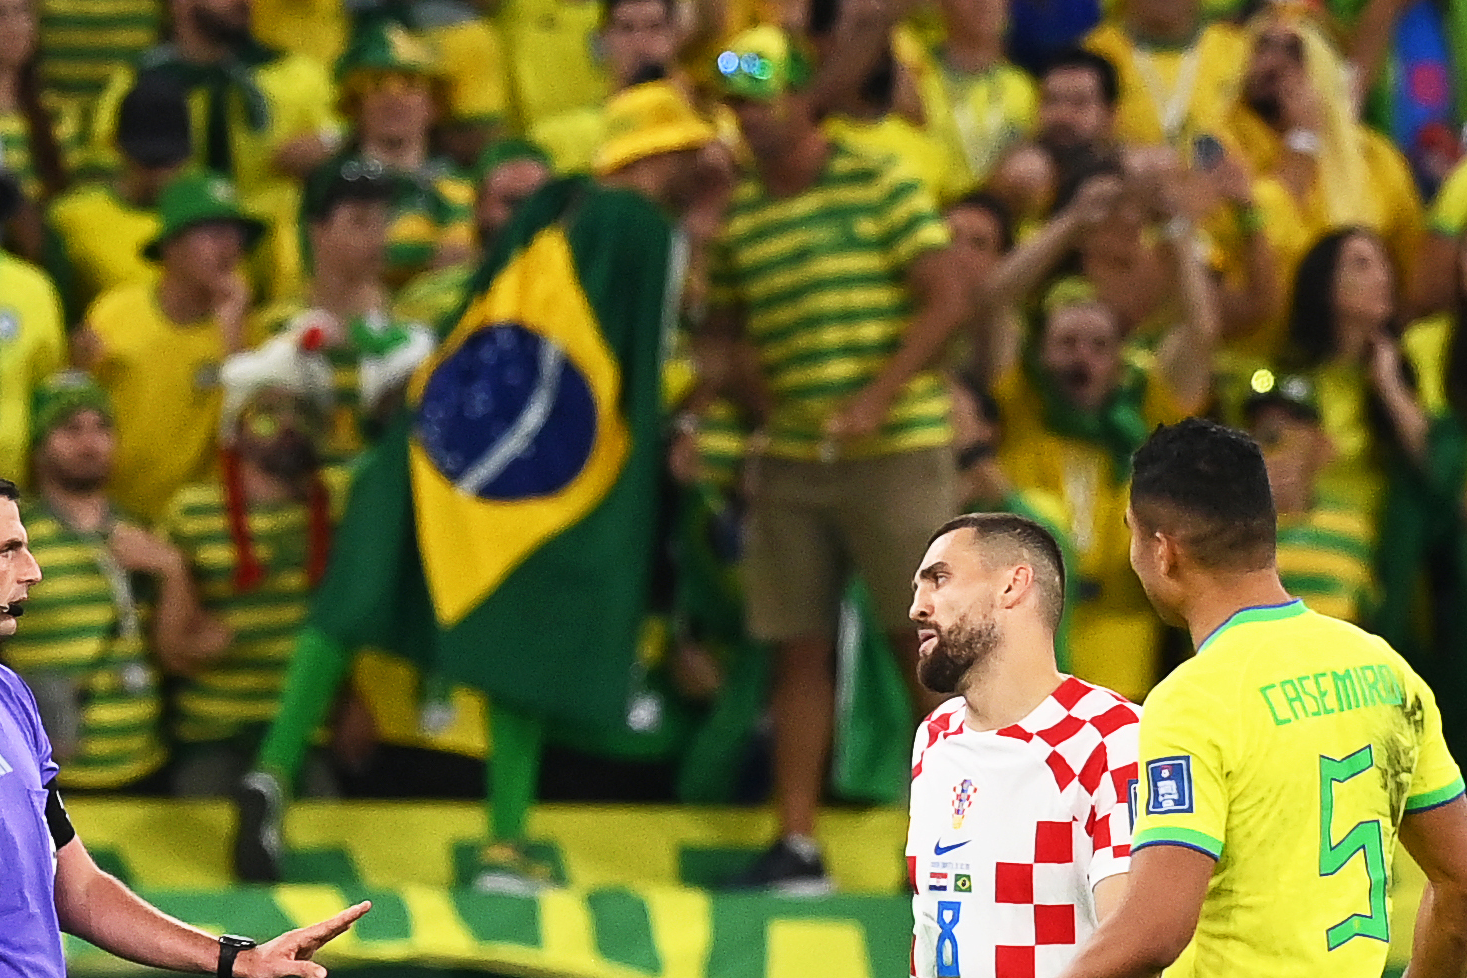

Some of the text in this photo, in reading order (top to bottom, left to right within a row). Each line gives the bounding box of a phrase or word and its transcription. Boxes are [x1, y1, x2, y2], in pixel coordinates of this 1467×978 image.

[1260, 664, 1403, 726] CASEMIRO
[1319, 743, 1390, 952] 5
[936, 901, 962, 977] 8
